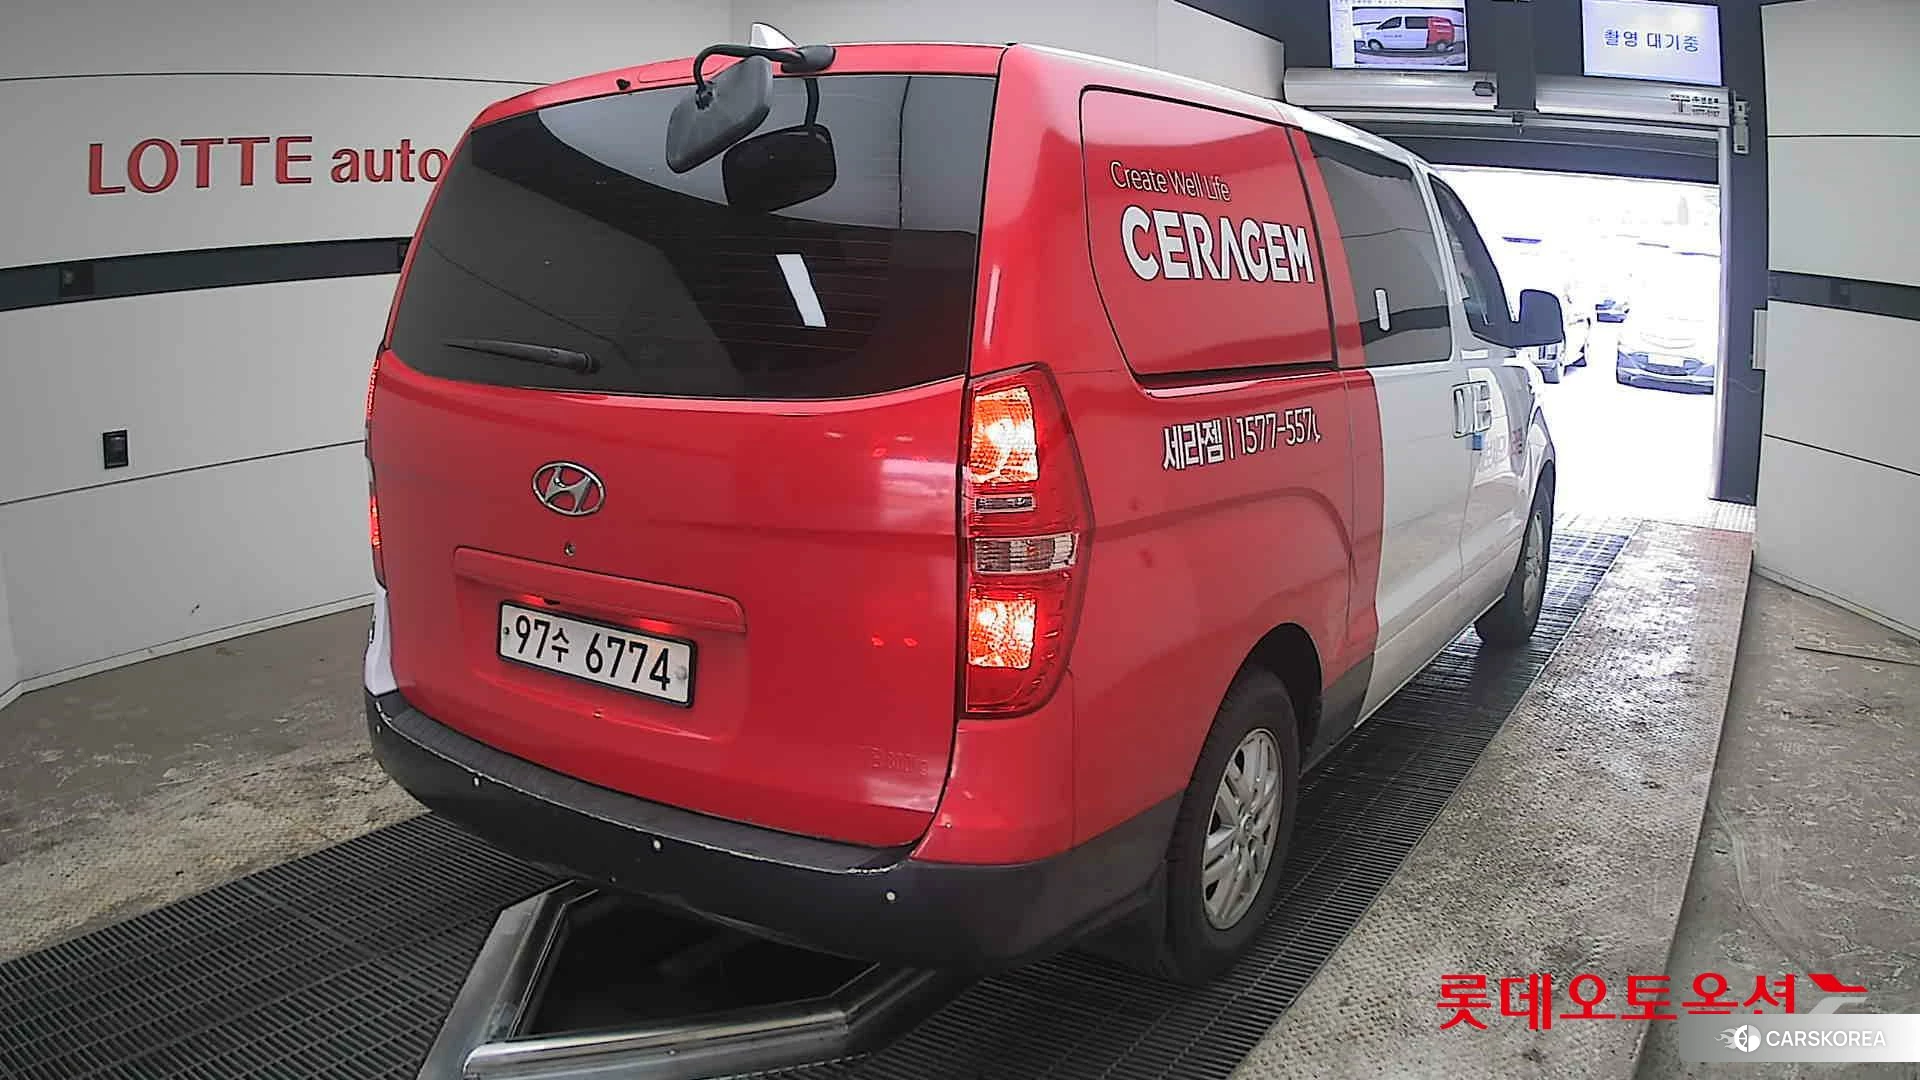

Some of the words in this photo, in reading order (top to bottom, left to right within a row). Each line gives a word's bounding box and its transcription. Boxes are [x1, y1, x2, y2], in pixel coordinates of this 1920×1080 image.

[1603, 29, 1638, 48] 촬영
[1646, 31, 1700, 53] 대기중
[88, 135, 314, 195] LOTTE
[330, 138, 451, 184] auto
[1110, 160, 1168, 194] Create
[1169, 169, 1204, 198] Well
[1205, 175, 1232, 202] Life
[1121, 205, 1315, 284] CERAGEM
[1162, 419, 1225, 470] 세라젬
[515, 614, 570, 664] 97수
[585, 632, 671, 692] 6774
